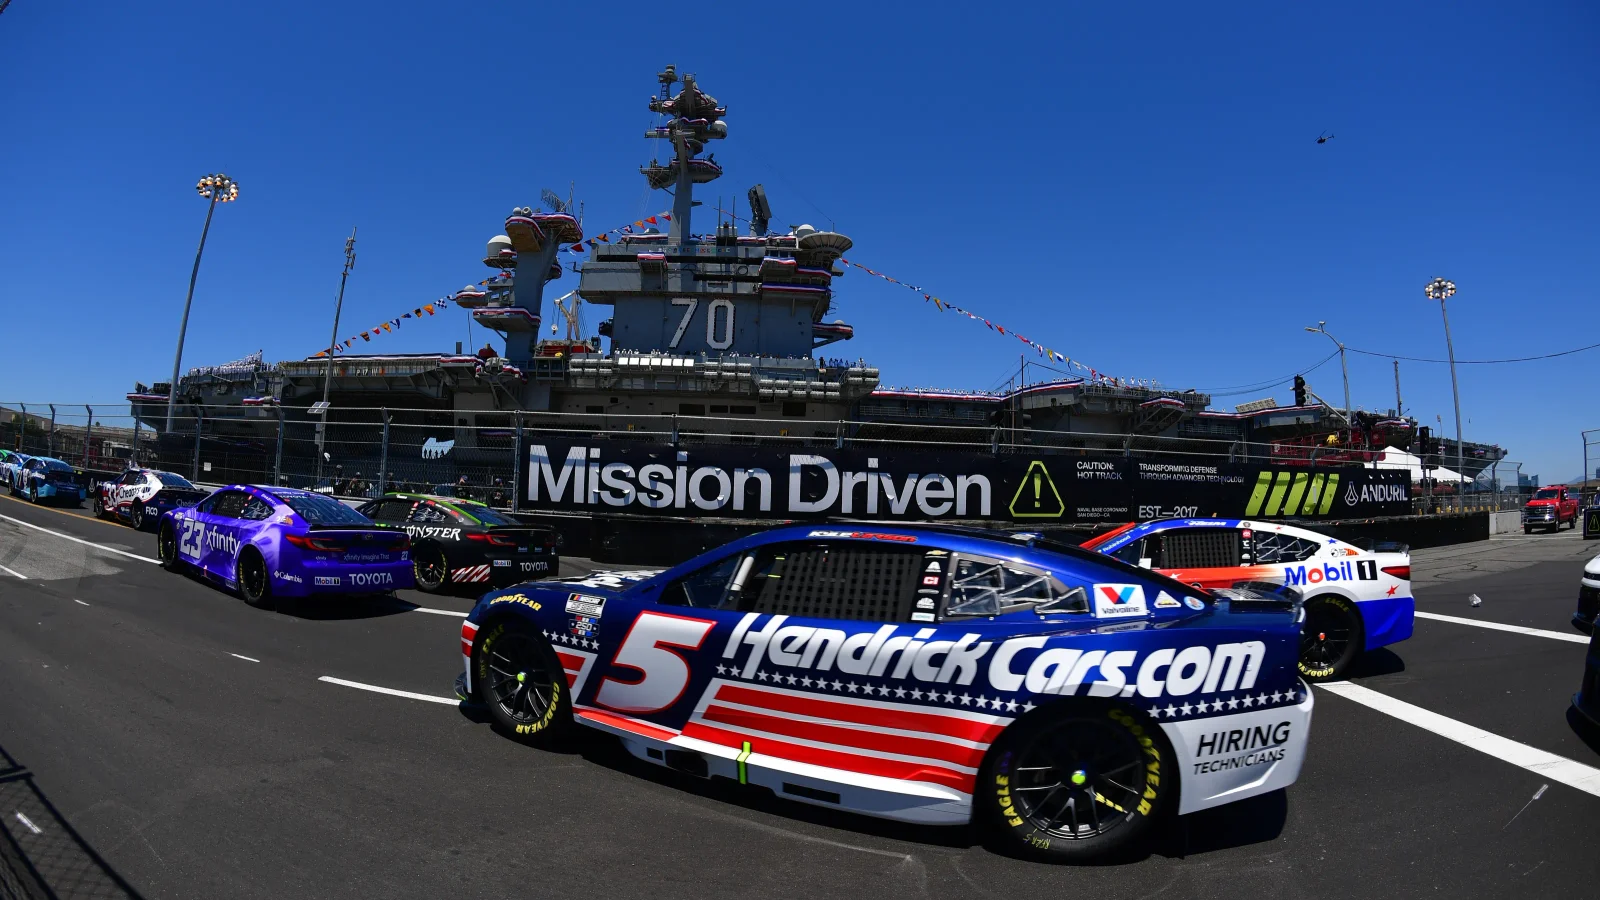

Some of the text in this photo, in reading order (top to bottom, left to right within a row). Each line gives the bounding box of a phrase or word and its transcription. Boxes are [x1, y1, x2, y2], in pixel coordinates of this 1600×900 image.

[669, 298, 735, 350] 70
[1076, 461, 1115, 470] CAUTION:
[1139, 463, 1218, 474] TRANSFORMING DEFENSE
[528, 444, 991, 516] Mission Driven
[1077, 471, 1123, 480] HOT TRACK
[1139, 472, 1245, 484] THROUGH ADVANCED TECHNOLOGY
[1360, 484, 1408, 503] ANDURIL
[145, 506, 158, 516] FICO
[180, 517, 206, 559] 23
[396, 525, 462, 541] ONSTER
[206, 525, 241, 560] xfinity
[520, 562, 549, 572] TOYOTA
[1284, 560, 1353, 586] Mobil
[279, 571, 303, 584] Columbia
[315, 577, 333, 585] Mobil
[349, 572, 393, 585] TOYOTA
[489, 593, 542, 611] GOODYEAR
[1101, 606, 1140, 615] Valvoline
[593, 610, 718, 715] 5
[722, 612, 1267, 699] HendrickCars.com
[515, 681, 561, 735] GOODYEAR
[1196, 720, 1291, 758] HIRING
[1193, 748, 1287, 775] TECHNICIANS
[995, 774, 1024, 827] EAGLE
